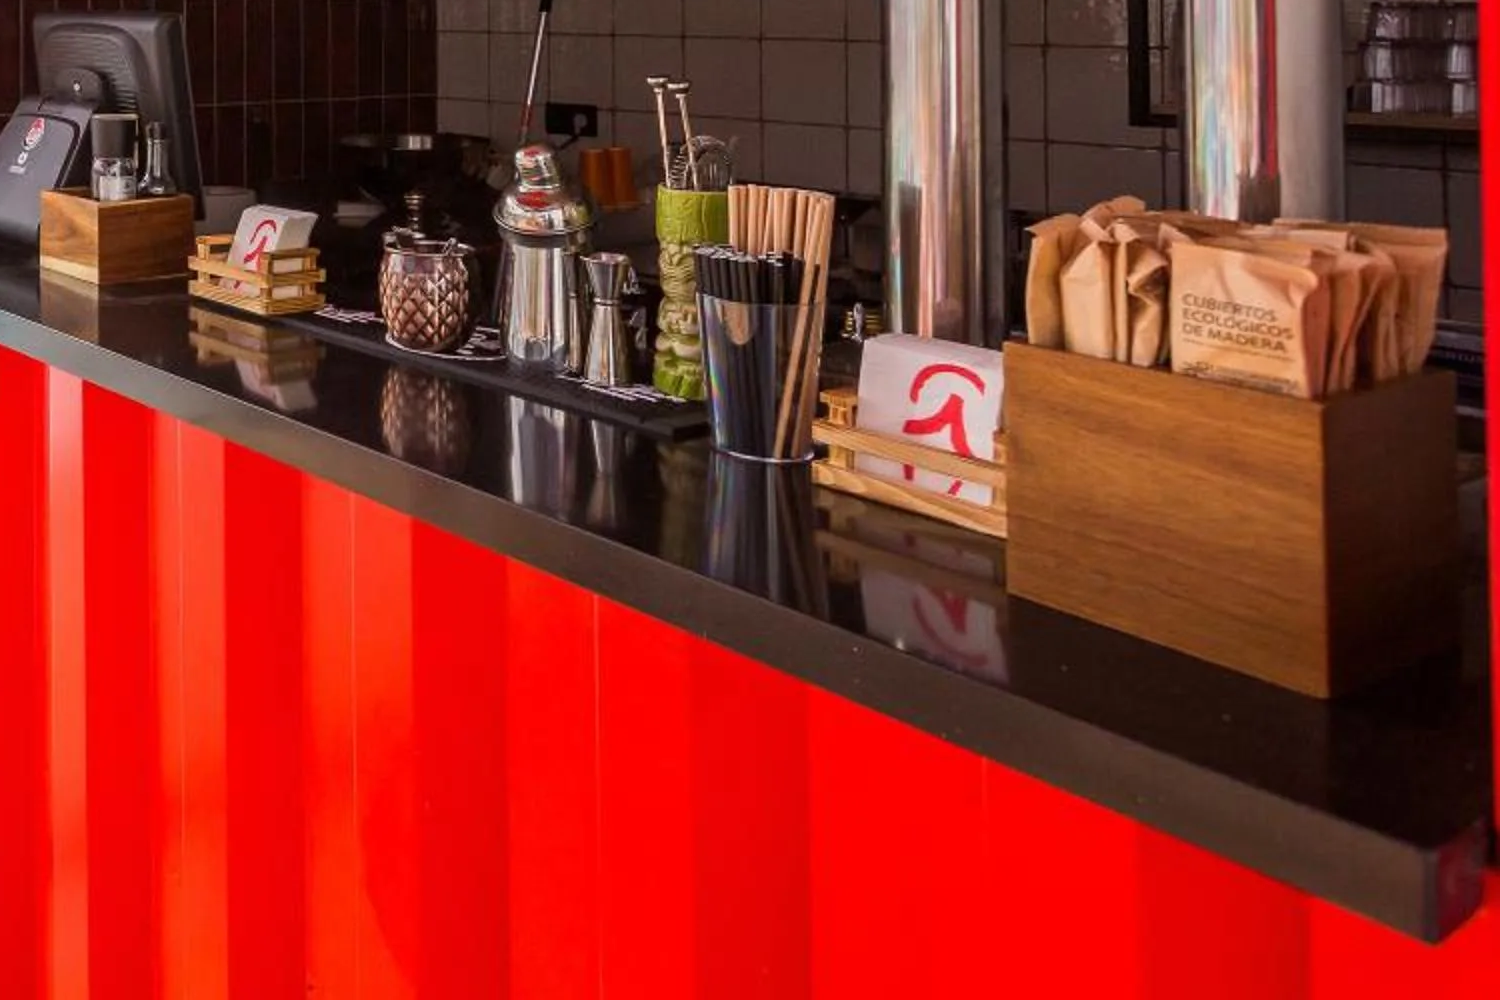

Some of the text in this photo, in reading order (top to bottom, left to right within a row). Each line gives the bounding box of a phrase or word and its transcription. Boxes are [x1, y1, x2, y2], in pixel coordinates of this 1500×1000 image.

[1182, 293, 1278, 323] CUBIERTOS
[1182, 323, 1203, 337] DE
[1207, 328, 1289, 354] MADERA
